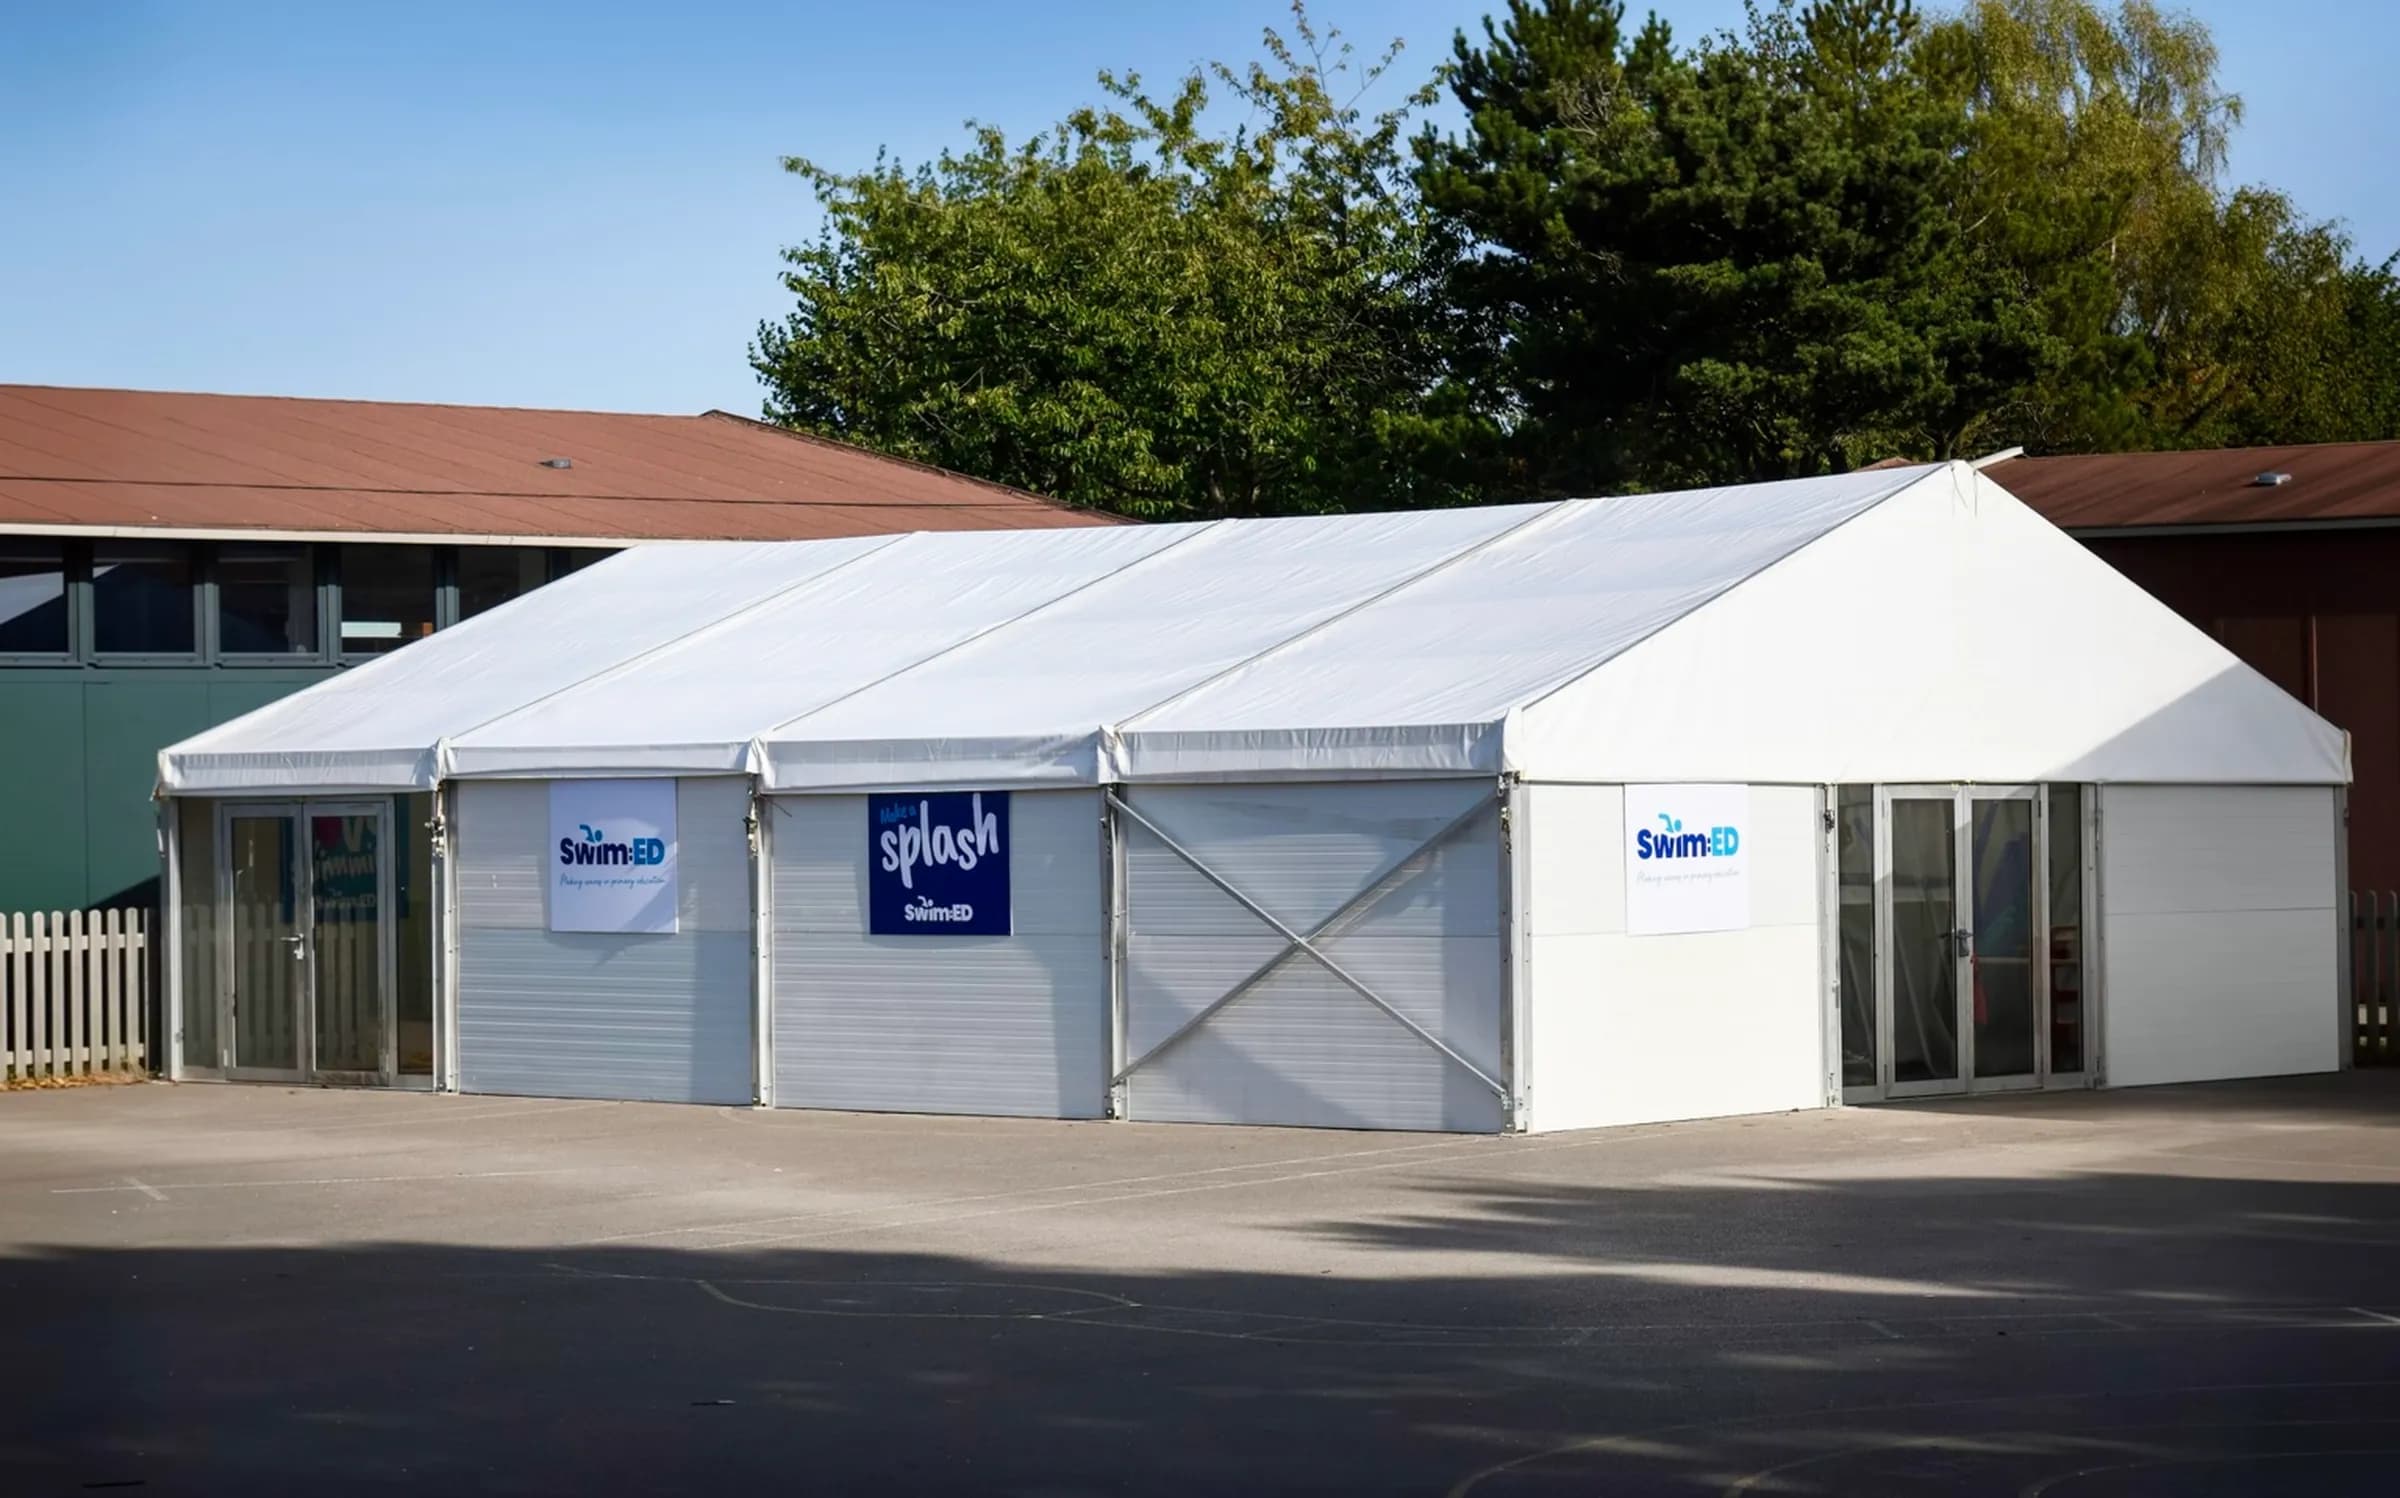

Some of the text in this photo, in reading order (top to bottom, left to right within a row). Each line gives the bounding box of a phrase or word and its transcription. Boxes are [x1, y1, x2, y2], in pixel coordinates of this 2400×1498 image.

[560, 837, 665, 866] Swim:ED
[880, 792, 999, 889] splash
[1636, 826, 1740, 860] Swim:ED
[904, 904, 974, 922] Swim:ED
